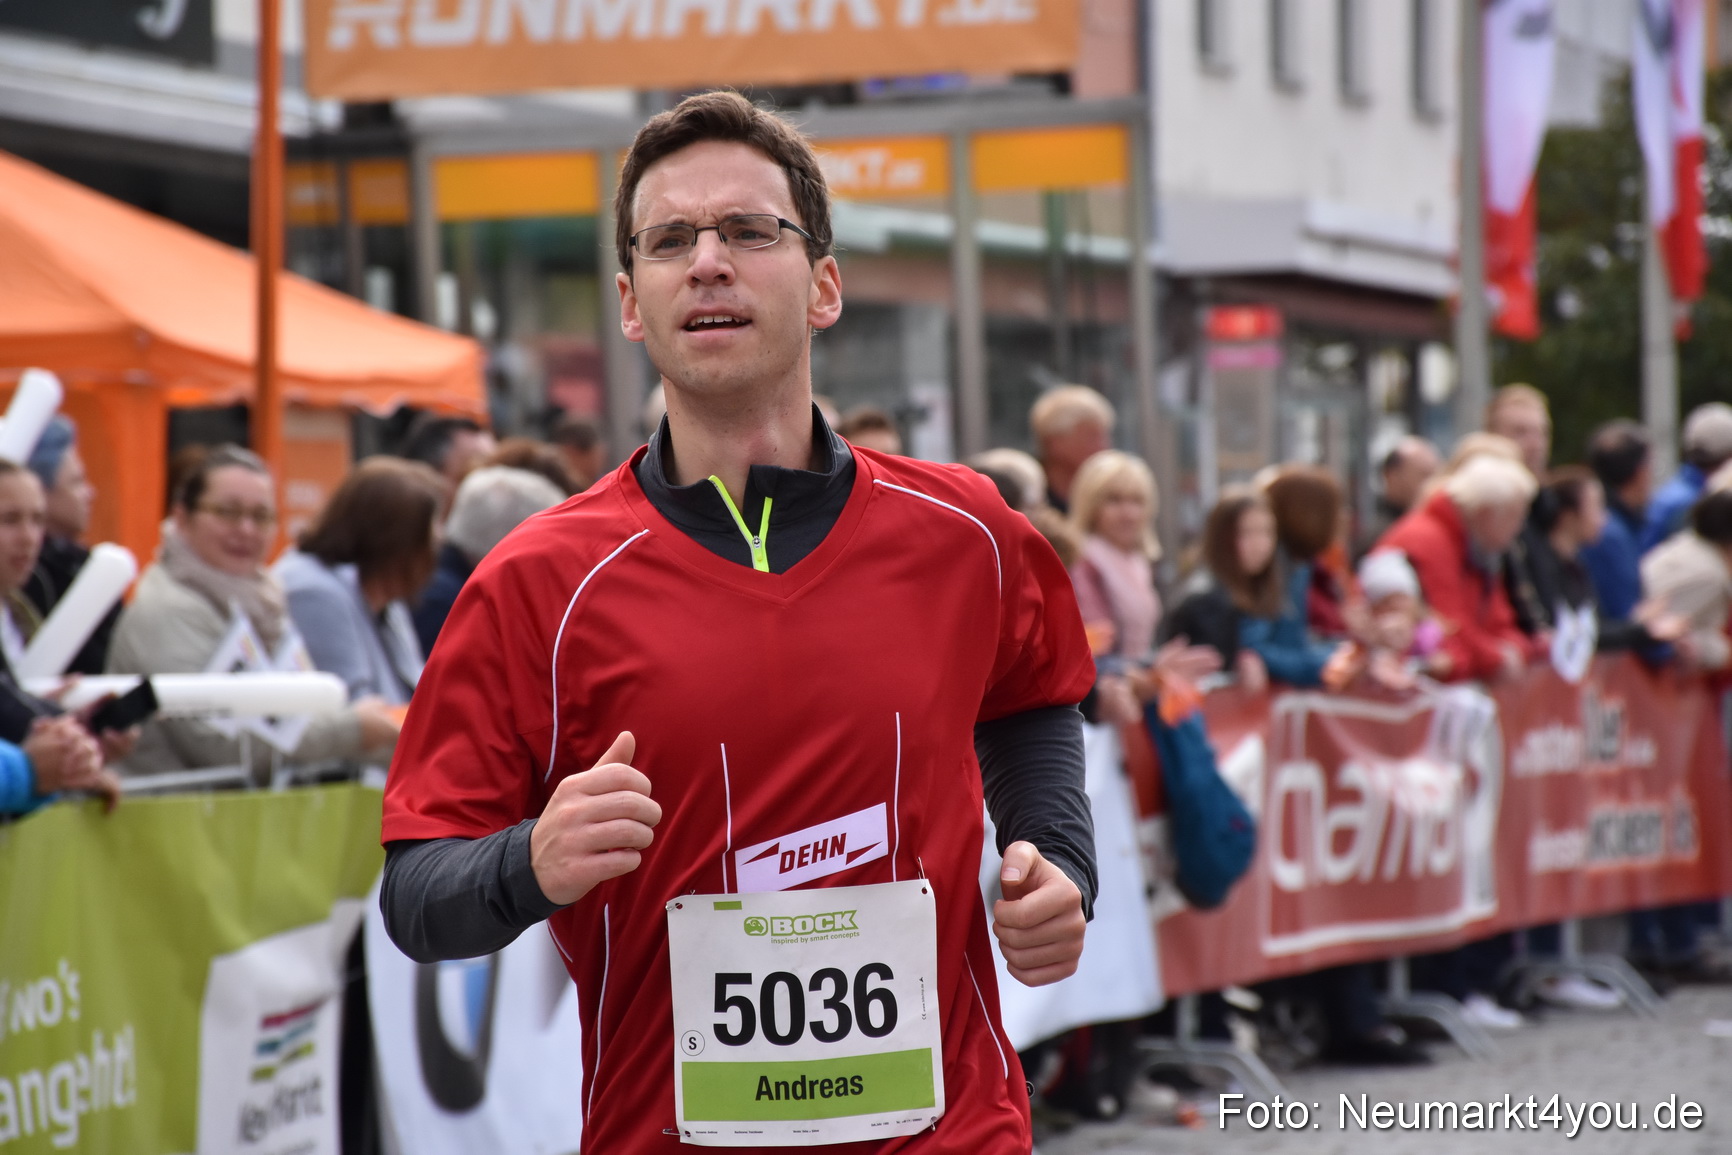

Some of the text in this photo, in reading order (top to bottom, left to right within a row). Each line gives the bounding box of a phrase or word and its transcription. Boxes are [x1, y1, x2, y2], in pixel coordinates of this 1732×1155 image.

[779, 833, 847, 874] DEHN
[770, 910, 859, 937] BOCK
[771, 931, 860, 946] inspired by smart concepts
[713, 962, 898, 1047] 5036
[688, 1036, 698, 1050] S
[755, 1075, 864, 1101] Andreas
